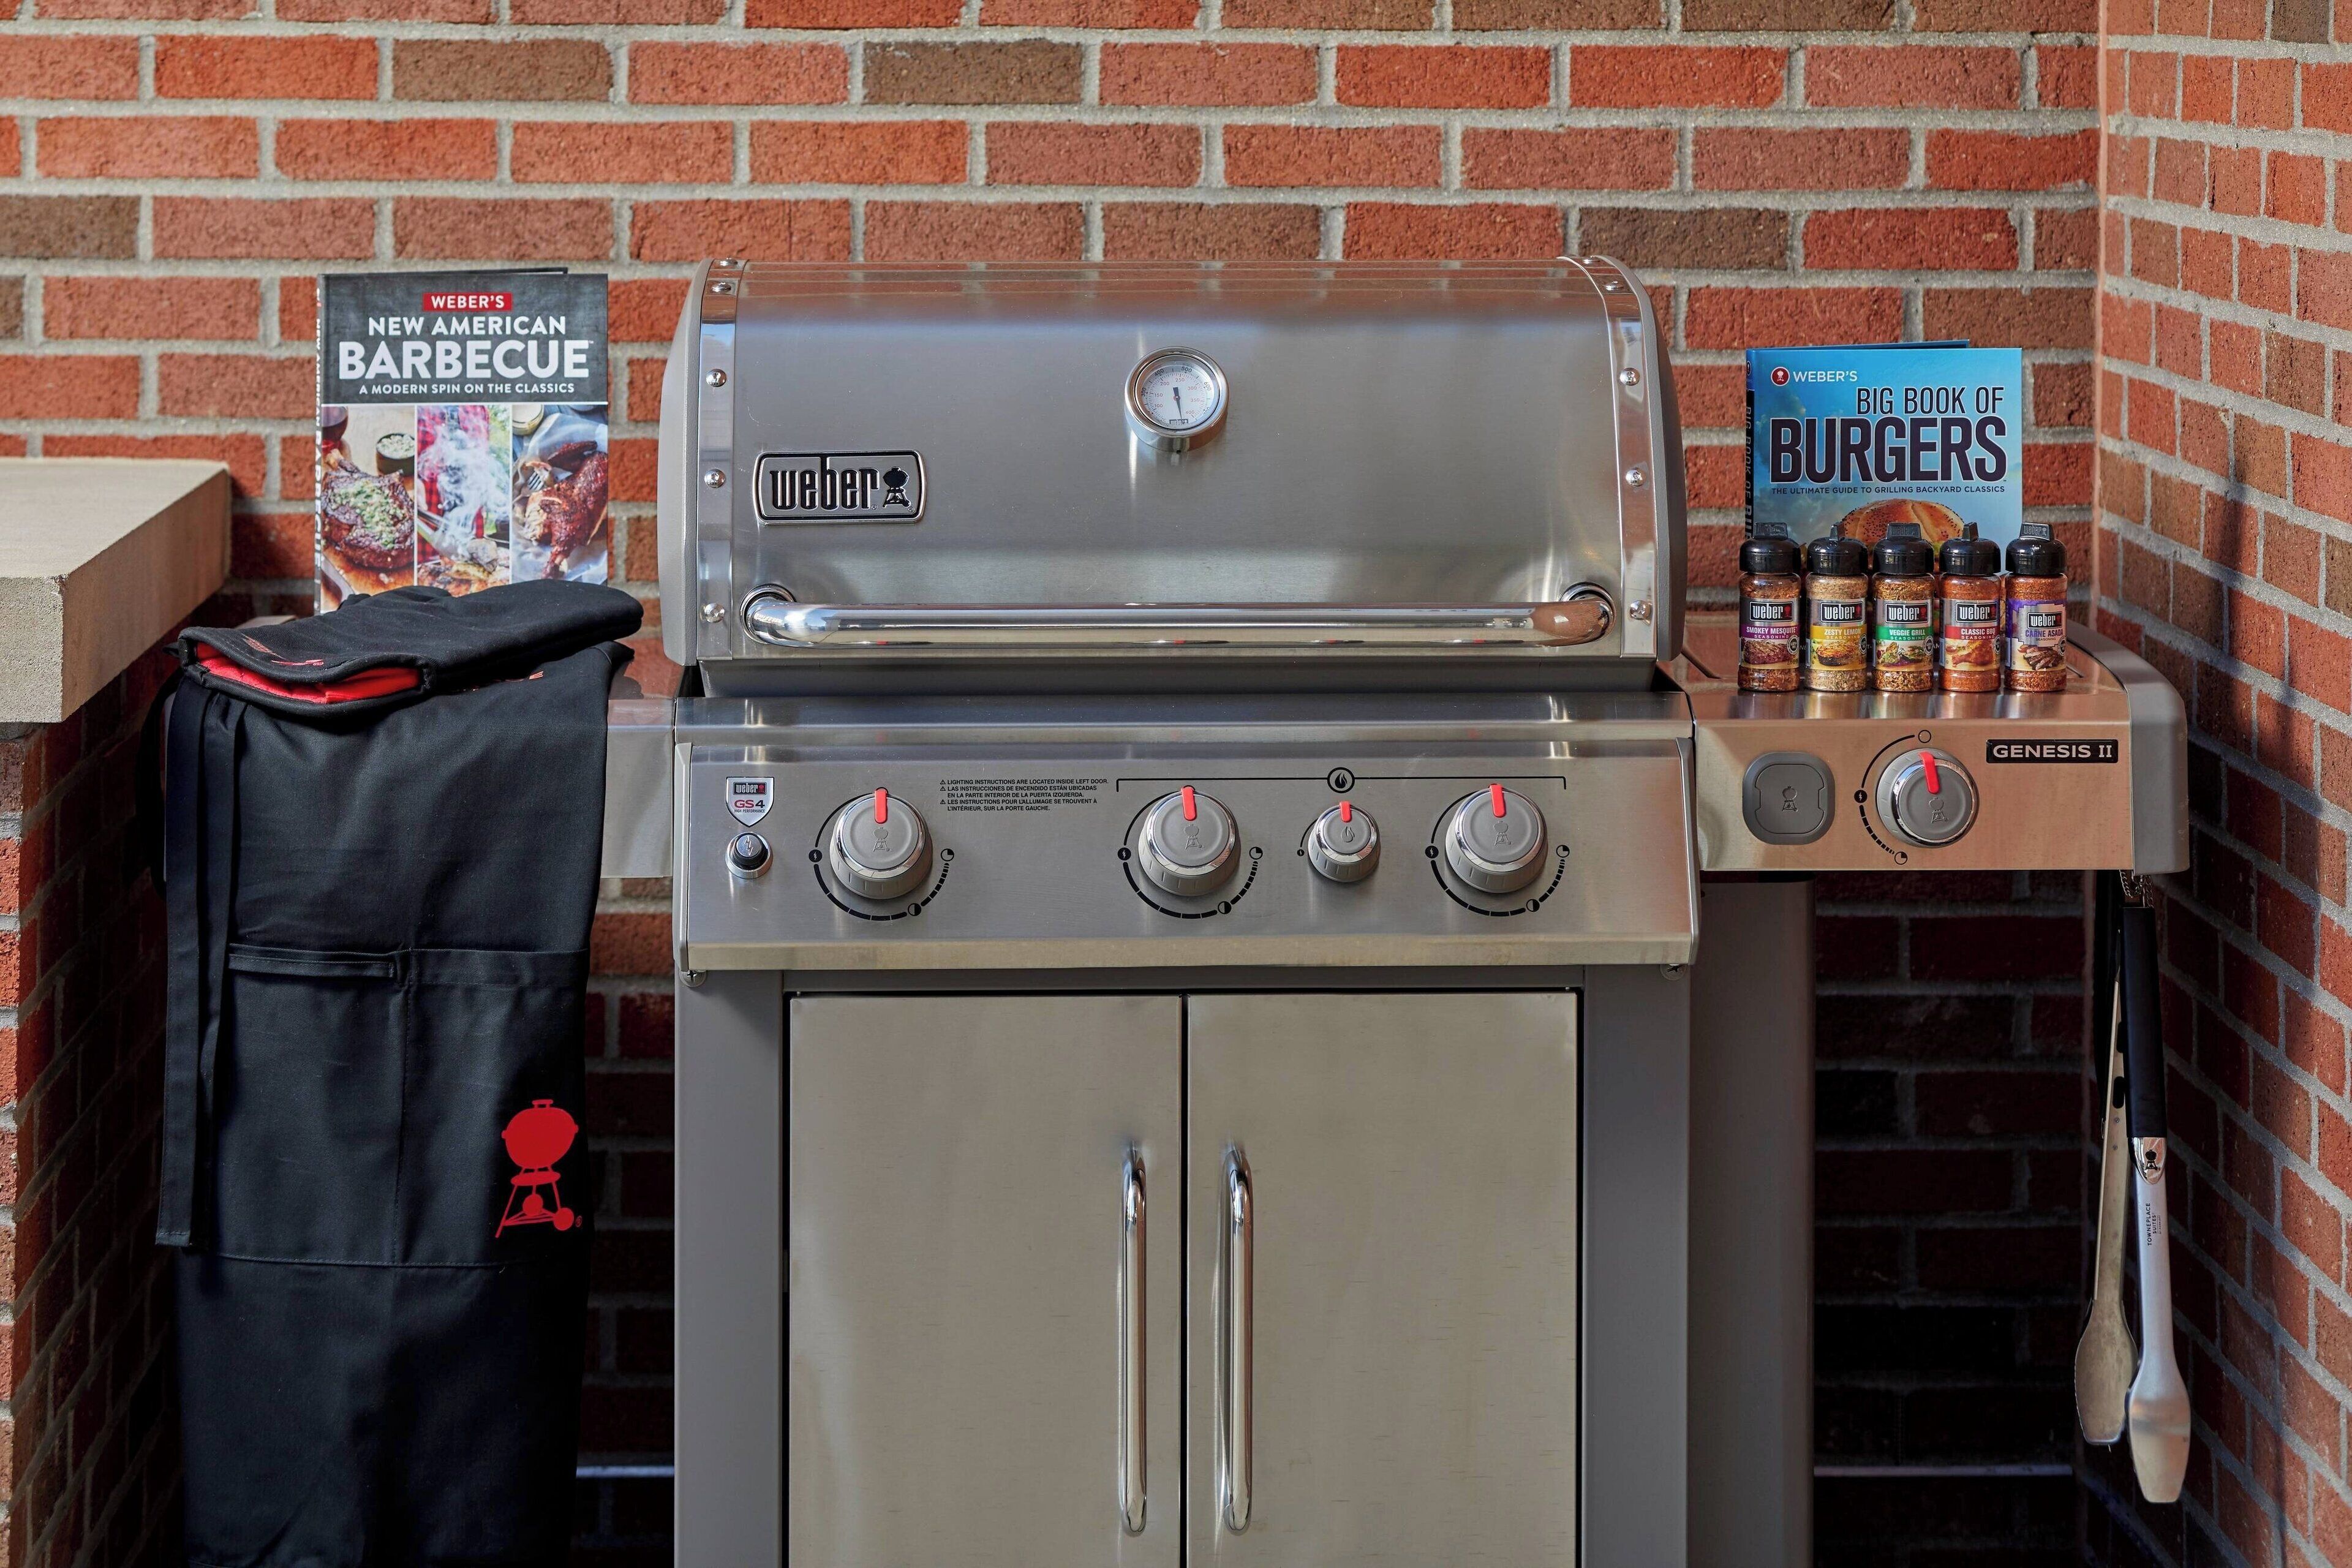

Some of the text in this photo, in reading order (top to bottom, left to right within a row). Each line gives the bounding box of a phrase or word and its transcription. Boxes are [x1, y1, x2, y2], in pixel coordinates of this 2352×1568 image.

[431, 295, 505, 309] WEBER'S
[368, 316, 566, 336] NEW AMERICAN
[339, 340, 589, 380] BARBECUE
[1793, 371, 1858, 382] WEBER'S
[359, 383, 575, 394] A MODERN SPIN ON THE CLASSICS
[1857, 386, 2004, 415] BIG BOOK OF
[1770, 417, 2007, 483] BURGERS
[770, 456, 879, 510] weber
[1752, 602, 1783, 619] weber
[1825, 603, 1855, 620] weber
[1889, 605, 1920, 620] weber
[1959, 604, 1989, 620] weber
[2030, 614, 2056, 626] weber
[1770, 627, 1795, 635] MESQUITE
[1993, 745, 2112, 758] GENESIS II
[736, 783, 758, 793] weber
[734, 799, 765, 809] GS4
